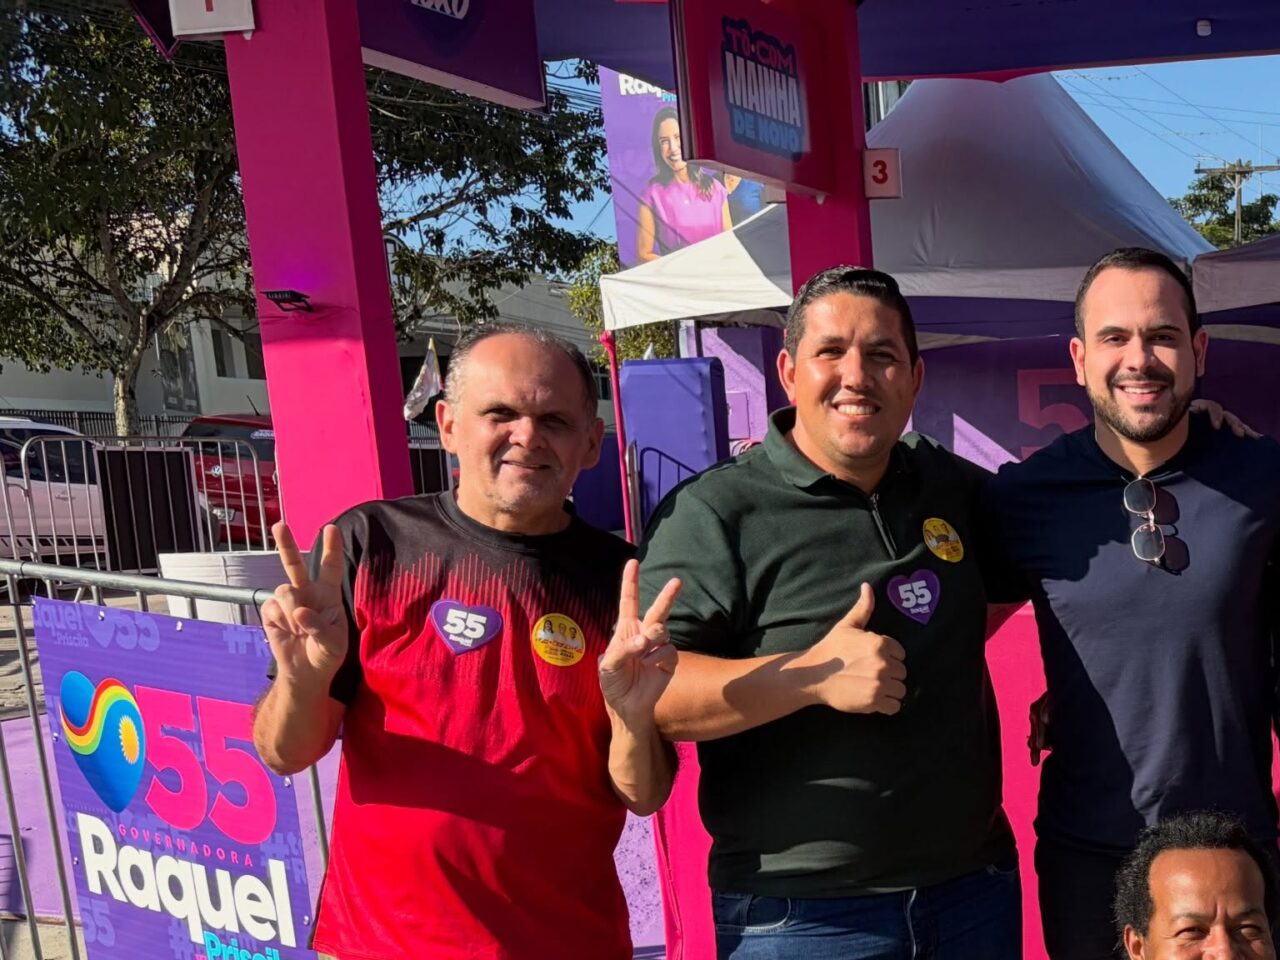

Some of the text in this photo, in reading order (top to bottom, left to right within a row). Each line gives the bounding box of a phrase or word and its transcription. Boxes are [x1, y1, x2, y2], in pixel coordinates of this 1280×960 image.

[725, 51, 800, 127] MAINHA
[734, 112, 798, 151] DE NOVO
[871, 160, 890, 185] 3
[898, 580, 932, 609] 55
[443, 608, 487, 639] 55
[134, 685, 277, 845] 55
[118, 823, 254, 868] GOVERNADORA
[77, 812, 297, 948] Raquel
